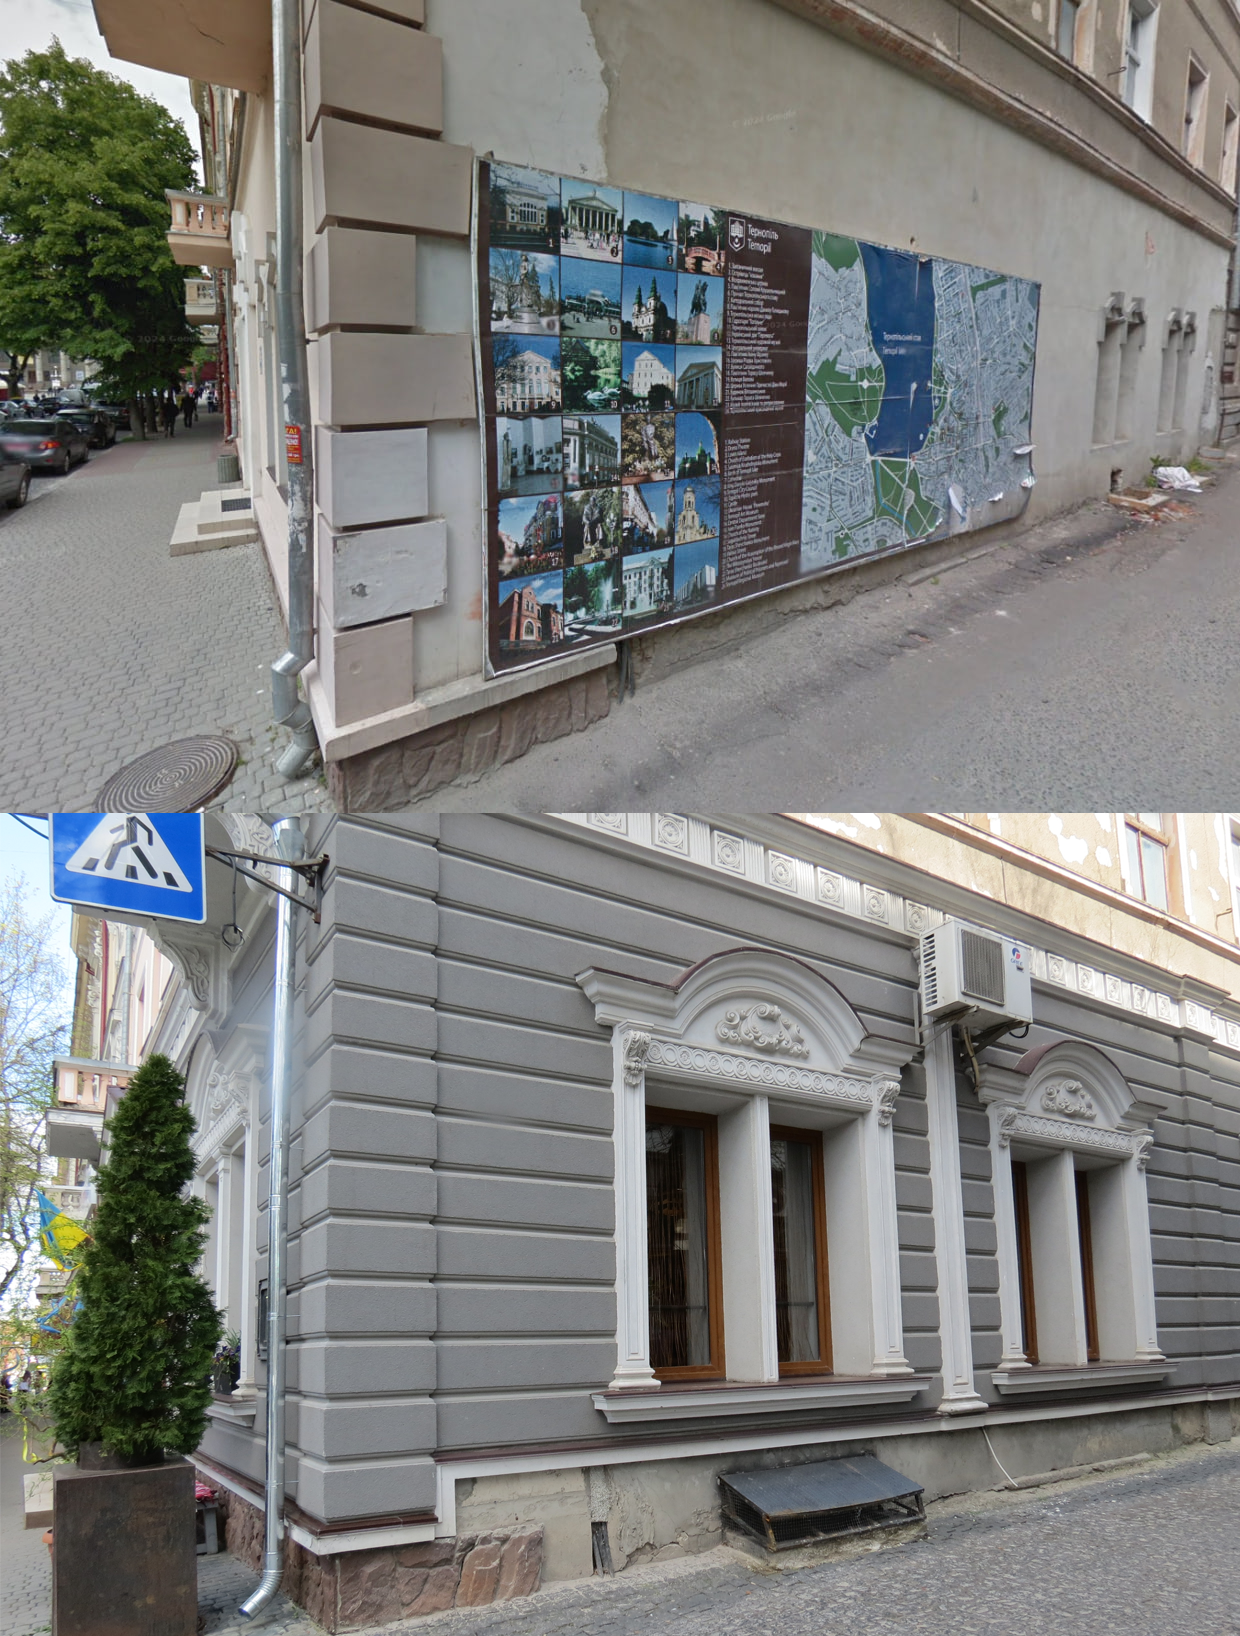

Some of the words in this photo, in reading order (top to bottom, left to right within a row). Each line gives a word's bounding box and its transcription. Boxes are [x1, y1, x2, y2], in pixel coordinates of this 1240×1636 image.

[748, 224, 778, 240] Тернопіль
[610, 400, 618, 408] 10
[552, 558, 559, 566] 17
